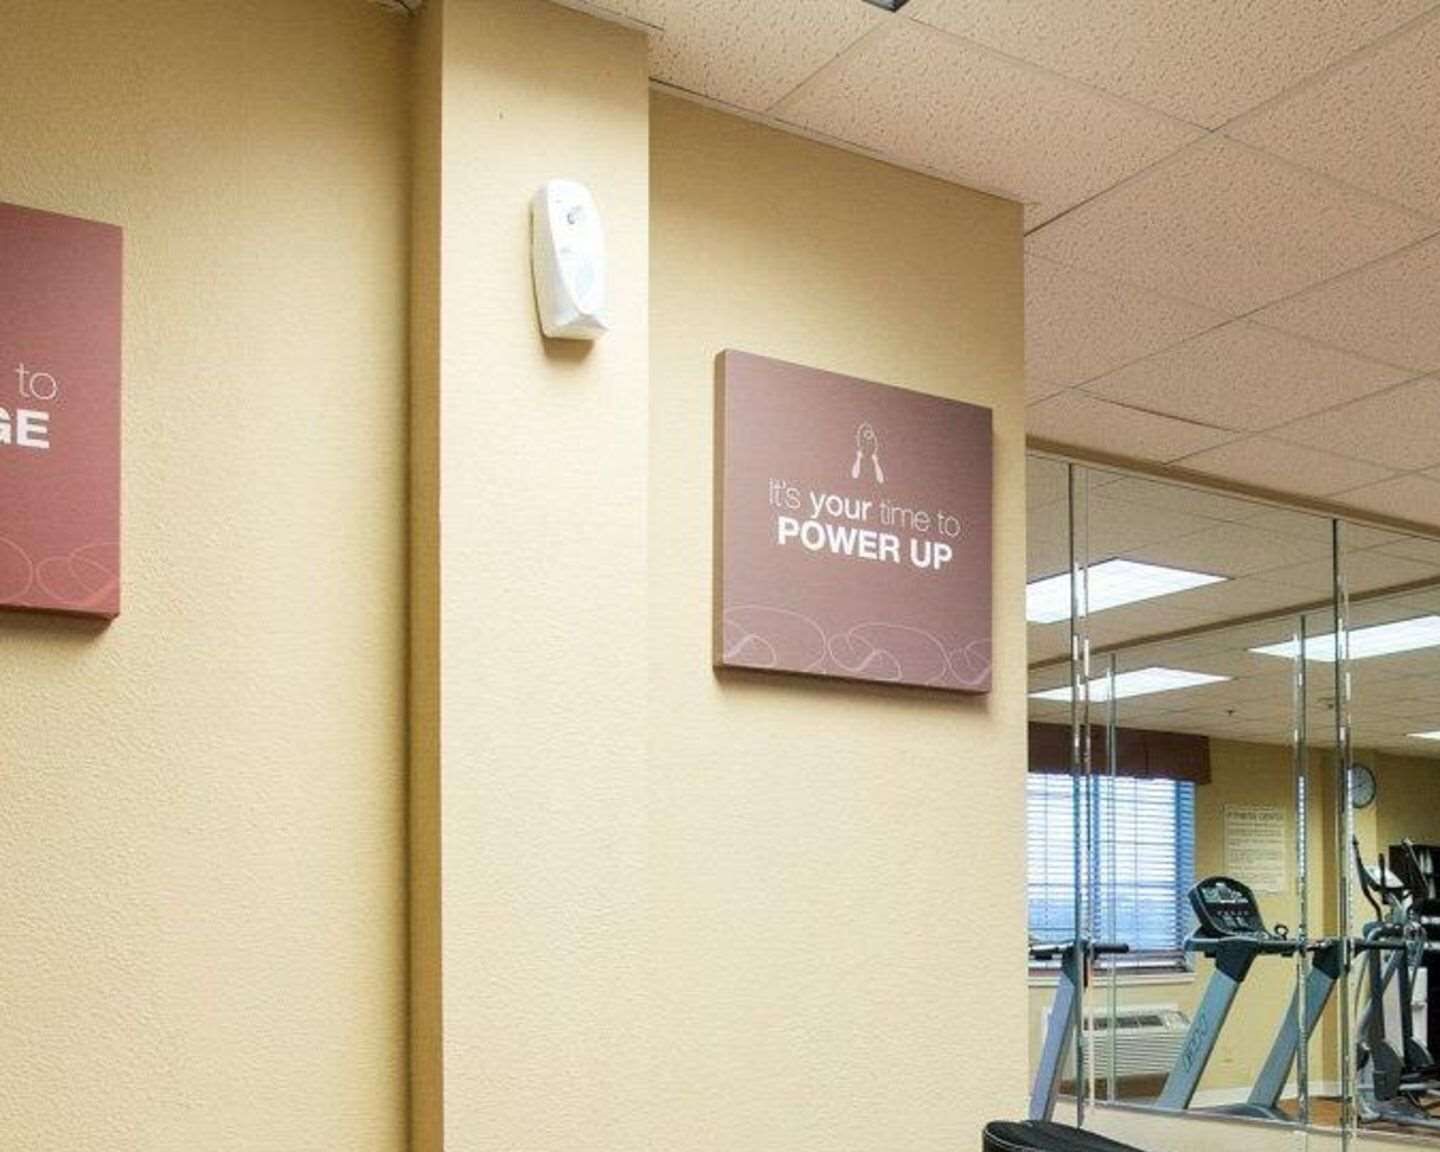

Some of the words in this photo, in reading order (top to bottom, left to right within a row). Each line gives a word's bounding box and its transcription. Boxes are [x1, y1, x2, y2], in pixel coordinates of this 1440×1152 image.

[15, 362, 57, 400] to
[809, 491, 873, 521] your
[880, 501, 931, 533] time
[936, 508, 961, 538] to
[777, 516, 901, 564] POWER
[910, 538, 953, 570] UP
